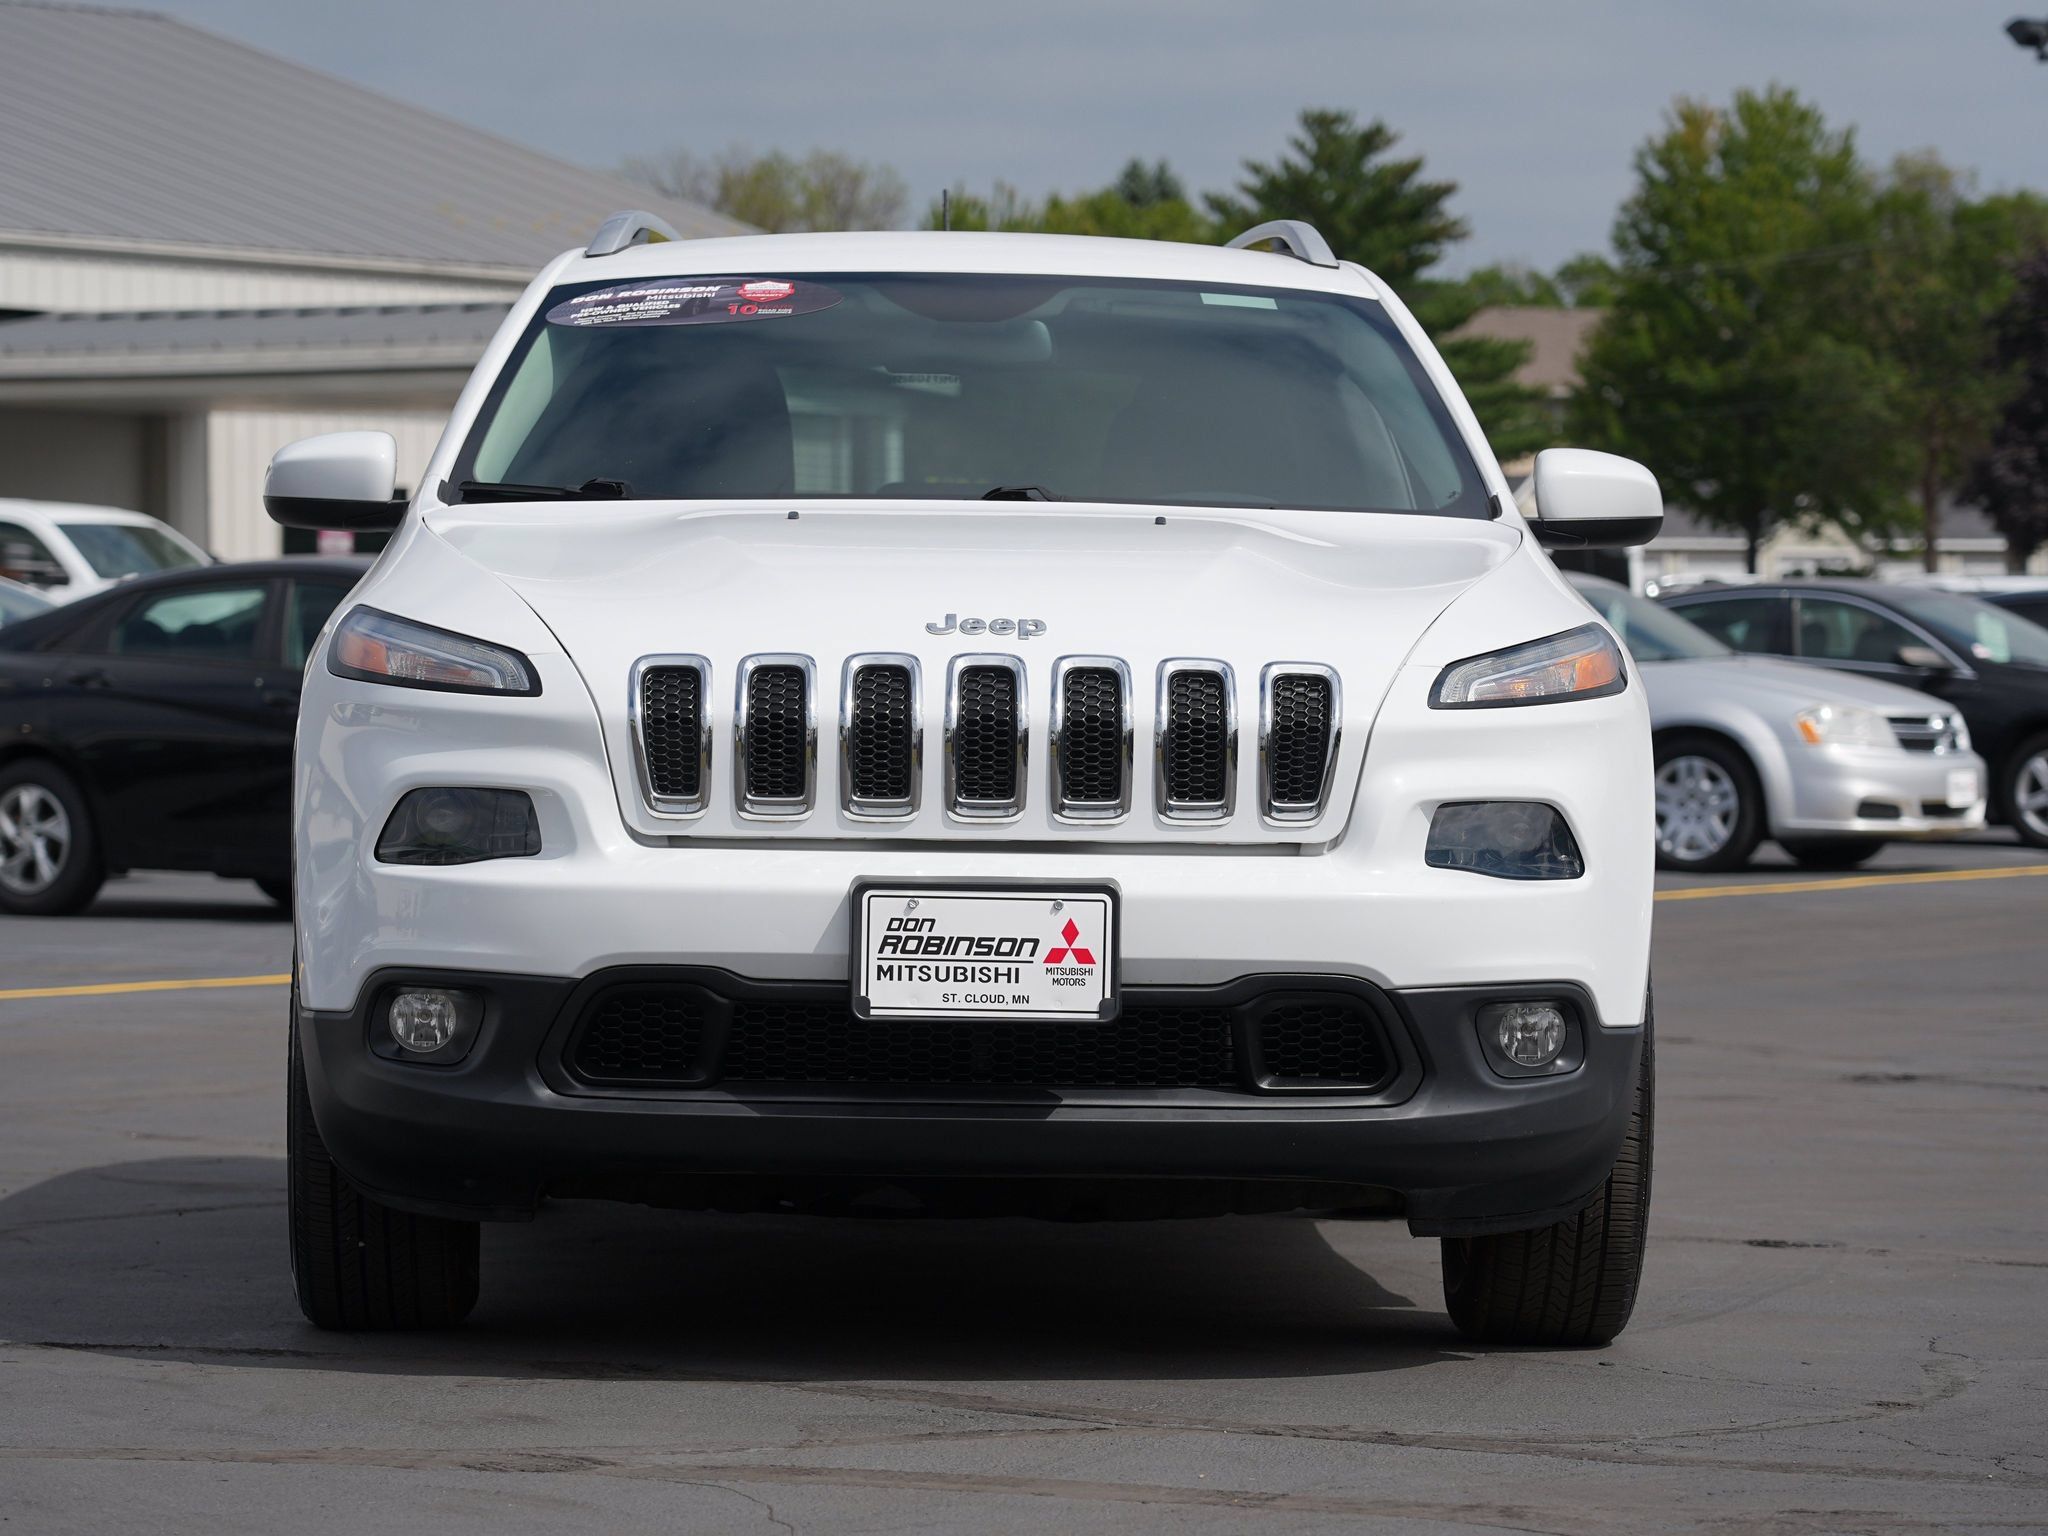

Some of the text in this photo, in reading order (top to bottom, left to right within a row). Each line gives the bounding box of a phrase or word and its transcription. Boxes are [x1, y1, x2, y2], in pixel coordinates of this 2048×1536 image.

[570, 285, 721, 304] DON ROBINSON
[646, 291, 716, 301] Mitsubishi
[616, 300, 670, 309] QUALIFIED
[632, 303, 681, 311] VEHICLES
[728, 303, 758, 315] 10
[925, 613, 1047, 640] Jeep
[886, 917, 936, 932] DON
[877, 934, 1040, 957] ROBINSON
[876, 964, 1020, 984] MITSUBISHI
[1045, 967, 1093, 976] MITSUBISHI
[1052, 977, 1086, 987] MOTORS
[942, 993, 1030, 1006] ST. CLOUD, MN
